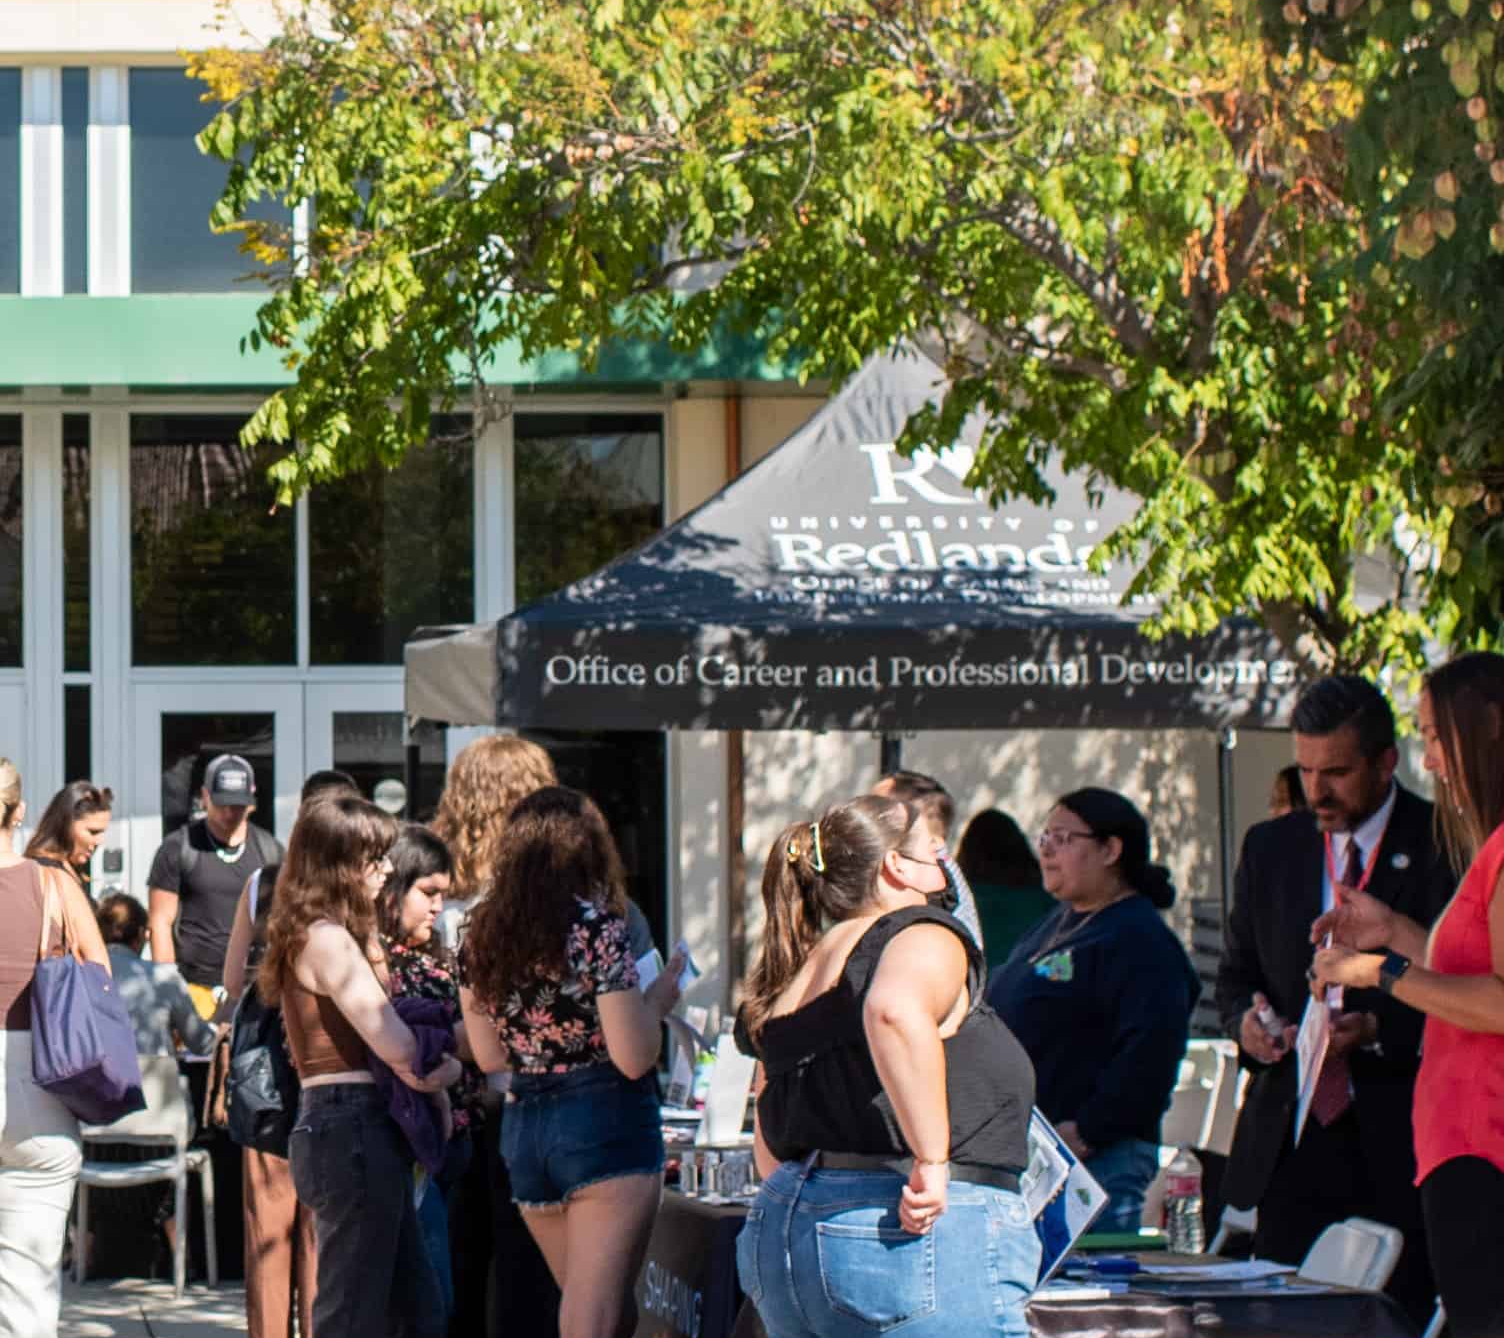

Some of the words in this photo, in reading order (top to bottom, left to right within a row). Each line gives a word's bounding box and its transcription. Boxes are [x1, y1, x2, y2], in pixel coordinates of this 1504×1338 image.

[769, 514, 1022, 532] UNIVERSITY
[1053, 516, 1100, 533] OF
[544, 655, 647, 687] Office
[654, 655, 691, 687] of
[696, 655, 808, 688] Career
[816, 656, 880, 687] and
[889, 654, 1091, 688] Professional
[1100, 653, 1299, 695] Developme
